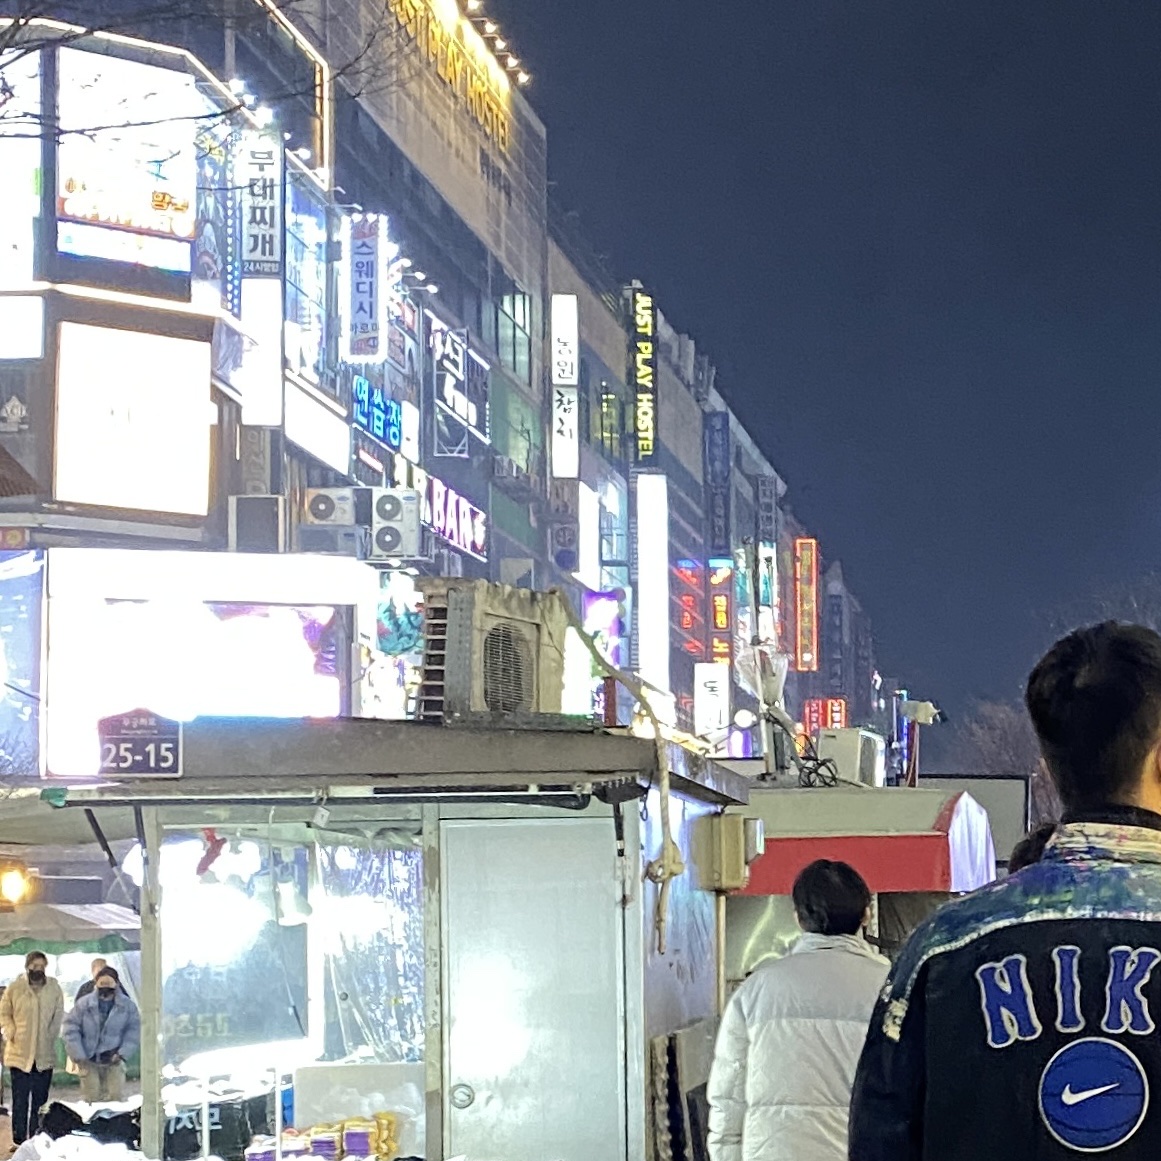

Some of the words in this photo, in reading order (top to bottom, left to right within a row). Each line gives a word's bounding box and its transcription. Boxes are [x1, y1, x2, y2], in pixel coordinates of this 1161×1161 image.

[353, 240, 375, 320] 스웨디시
[635, 292, 654, 336] JUST
[636, 341, 654, 389] PLAY
[636, 393, 654, 461] HOSTEL
[103, 743, 175, 768] 25-15
